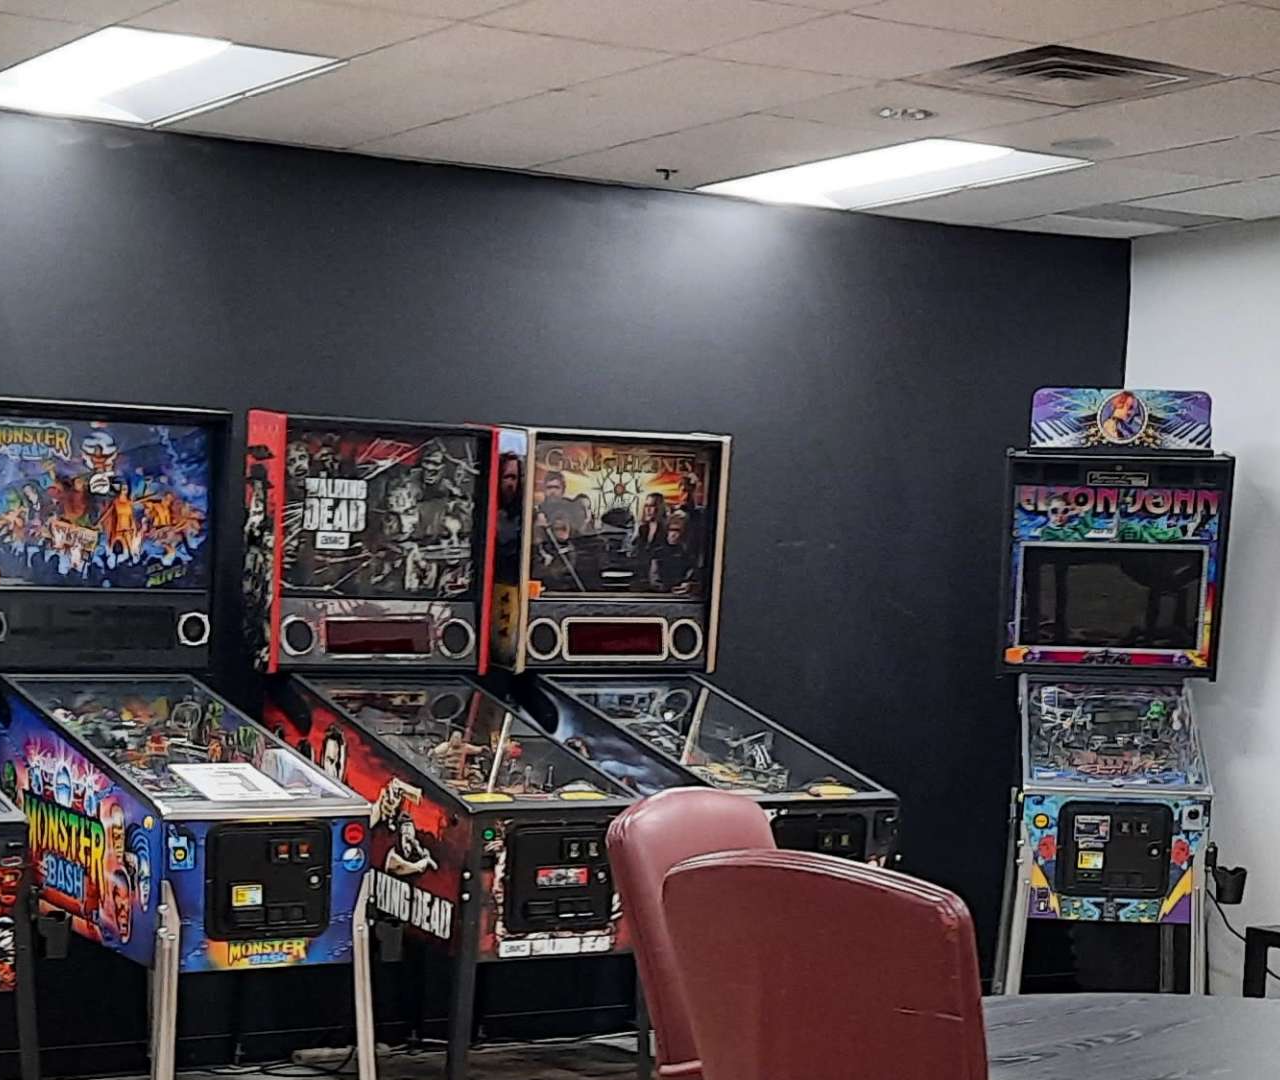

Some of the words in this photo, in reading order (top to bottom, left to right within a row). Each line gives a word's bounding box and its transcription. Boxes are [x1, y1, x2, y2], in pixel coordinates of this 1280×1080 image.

[303, 498, 367, 532] DEAD
[1127, 486, 1219, 516] JOHN
[24, 794, 112, 905] MONSTER
[45, 854, 81, 900] BASH
[411, 887, 454, 940] DEAD
[228, 938, 307, 966] MONSTER
